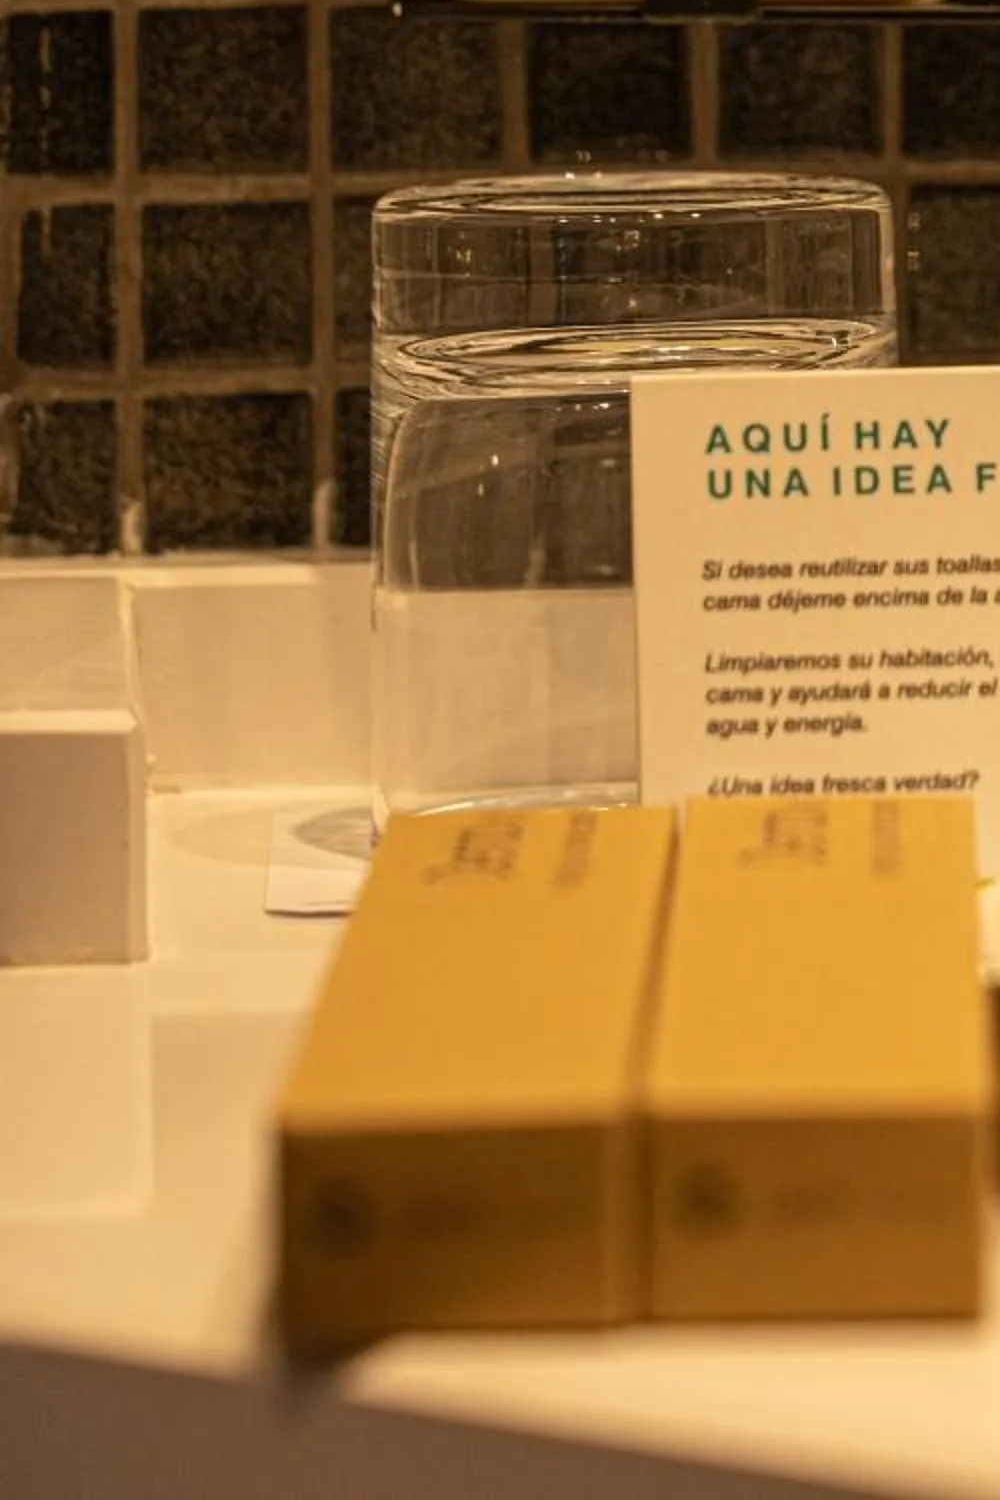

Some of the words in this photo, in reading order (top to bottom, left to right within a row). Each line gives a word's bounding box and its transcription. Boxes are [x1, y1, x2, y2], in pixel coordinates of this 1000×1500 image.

[705, 412, 832, 454] AQUÍ
[854, 418, 951, 450] HAY
[707, 467, 810, 500] UNA
[833, 463, 954, 497] IDEA
[702, 559, 723, 580] Si
[728, 560, 793, 579] desea
[799, 557, 888, 577] reutilizar
[893, 558, 929, 575] sus
[703, 593, 761, 612] cama
[767, 589, 846, 614] déjeme
[854, 588, 929, 608] encima
[936, 585, 963, 605] de
[969, 585, 988, 604] la
[705, 651, 841, 675] Limpiaremos
[848, 652, 872, 669] su
[879, 645, 994, 669] habitación,
[705, 684, 763, 704] cama
[769, 687, 781, 707] y
[788, 678, 871, 706] ayudará
[877, 684, 890, 700] a
[897, 677, 972, 699] reducir
[978, 678, 998, 696] el
[707, 718, 758, 740] agua
[764, 717, 777, 739] y
[783, 711, 868, 736] energía.
[708, 775, 763, 798] ¿Una
[769, 773, 815, 794] idea
[823, 772, 887, 793] fresca
[893, 768, 980, 791] verdad?
